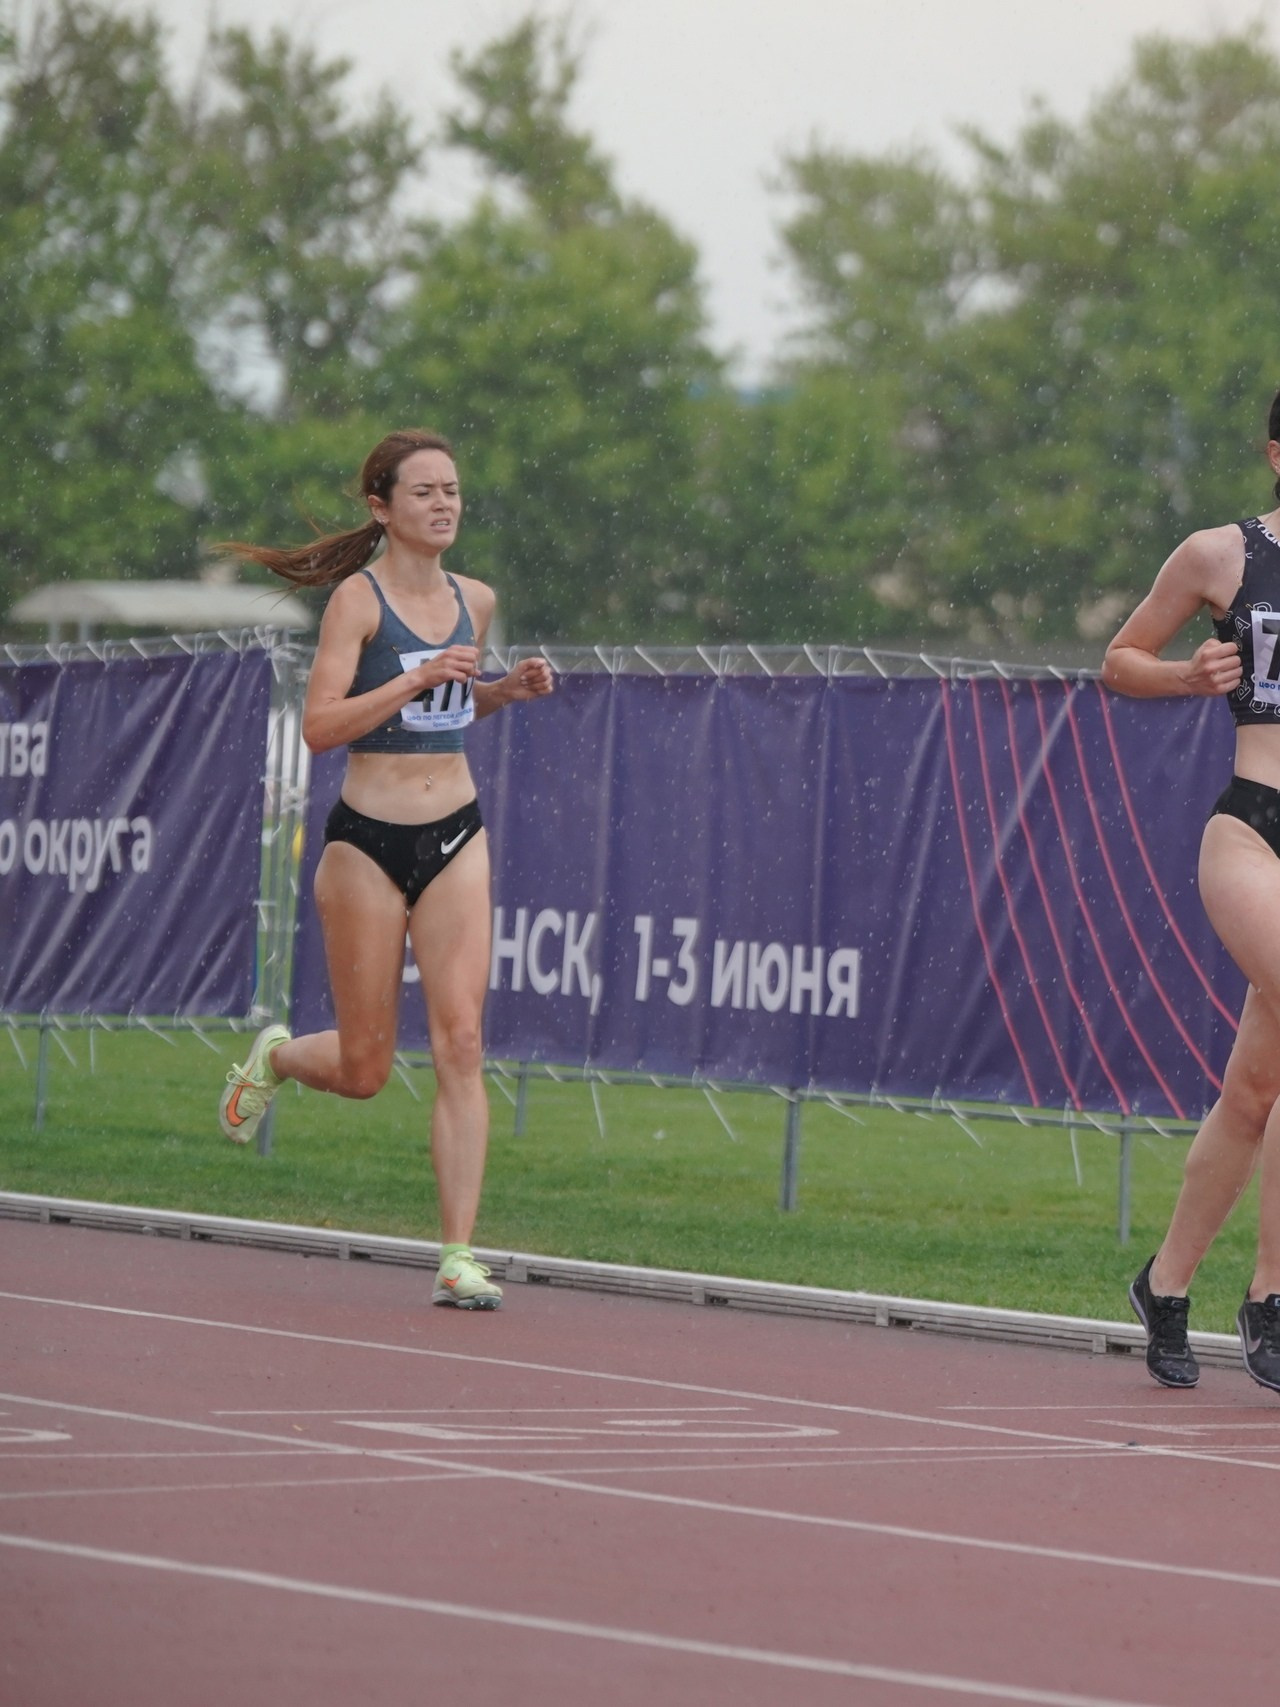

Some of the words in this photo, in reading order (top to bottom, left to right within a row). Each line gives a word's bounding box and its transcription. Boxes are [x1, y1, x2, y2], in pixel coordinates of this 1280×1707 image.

[1258, 681, 1276, 690] ЦФО
[24, 815, 152, 893] округа
[633, 914, 699, 1006] 1-3
[710, 938, 860, 1018] июня
